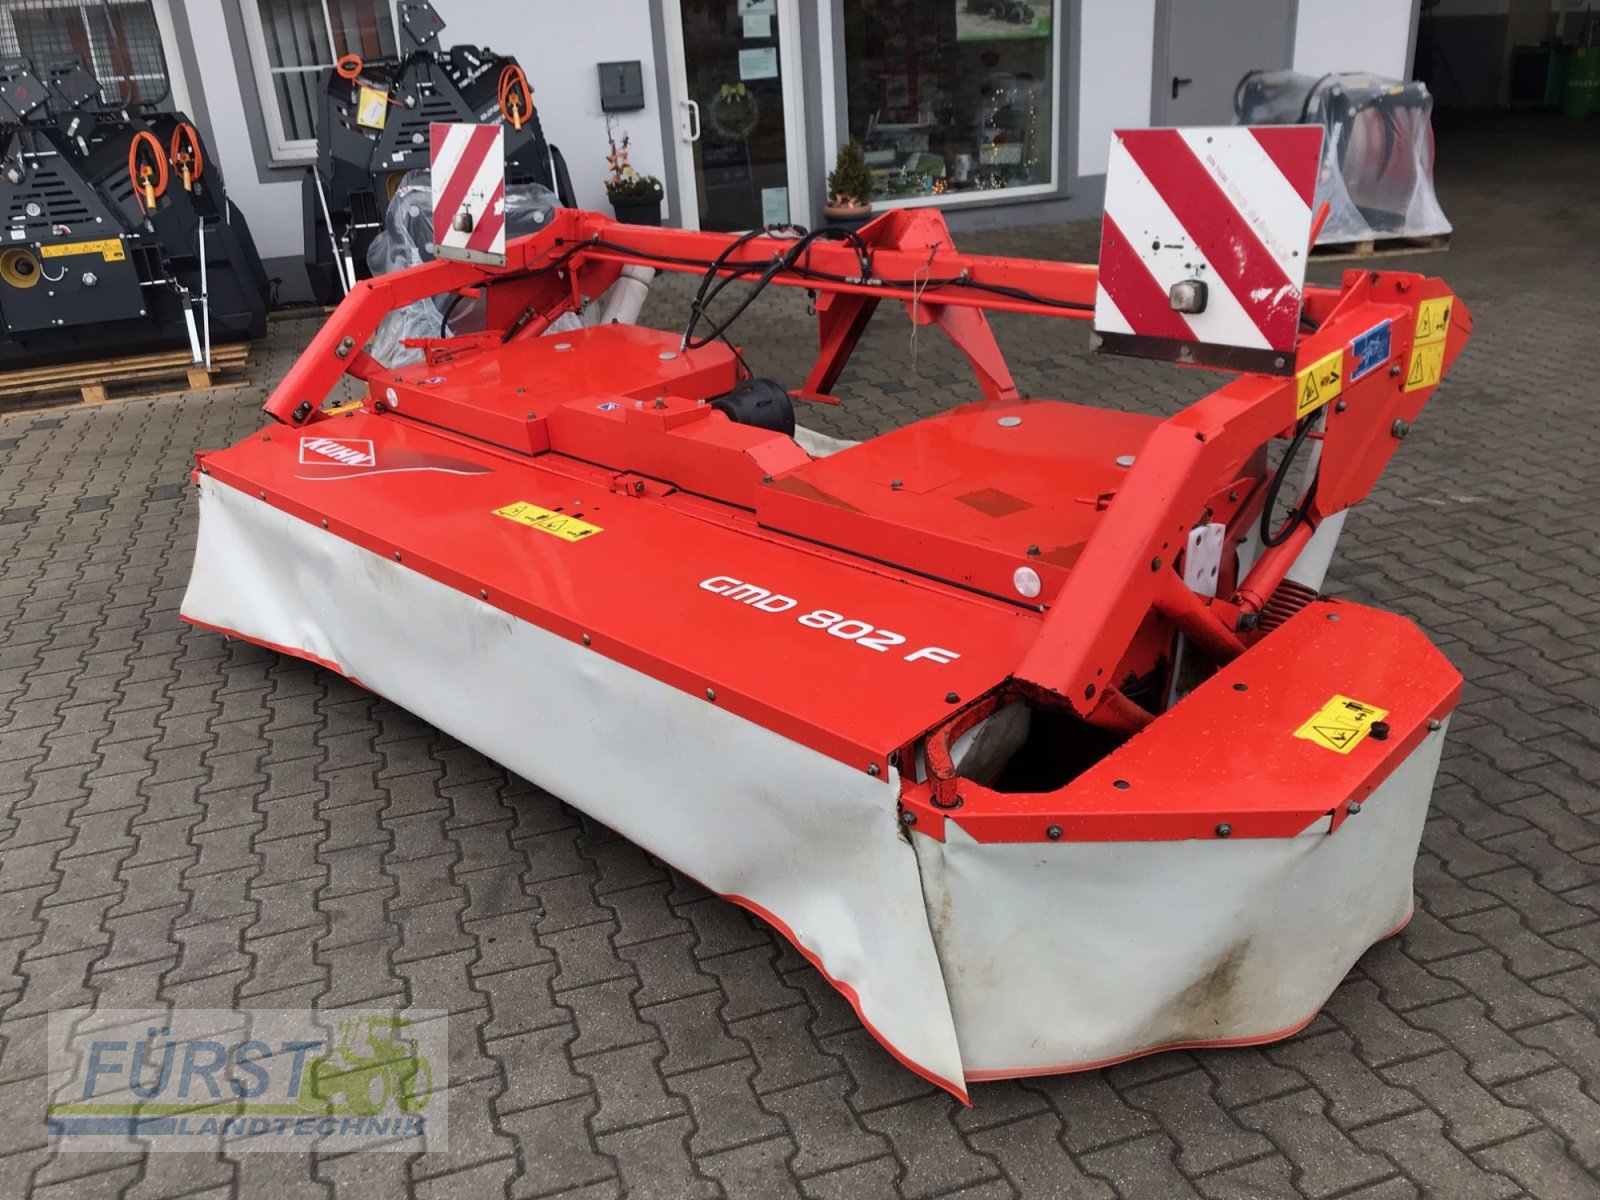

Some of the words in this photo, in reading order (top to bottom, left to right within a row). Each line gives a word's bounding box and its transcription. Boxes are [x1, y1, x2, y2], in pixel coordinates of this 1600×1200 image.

[303, 439, 372, 464] KUHN
[699, 575, 798, 613] GMD
[797, 610, 907, 652] 802
[903, 647, 961, 664] F
